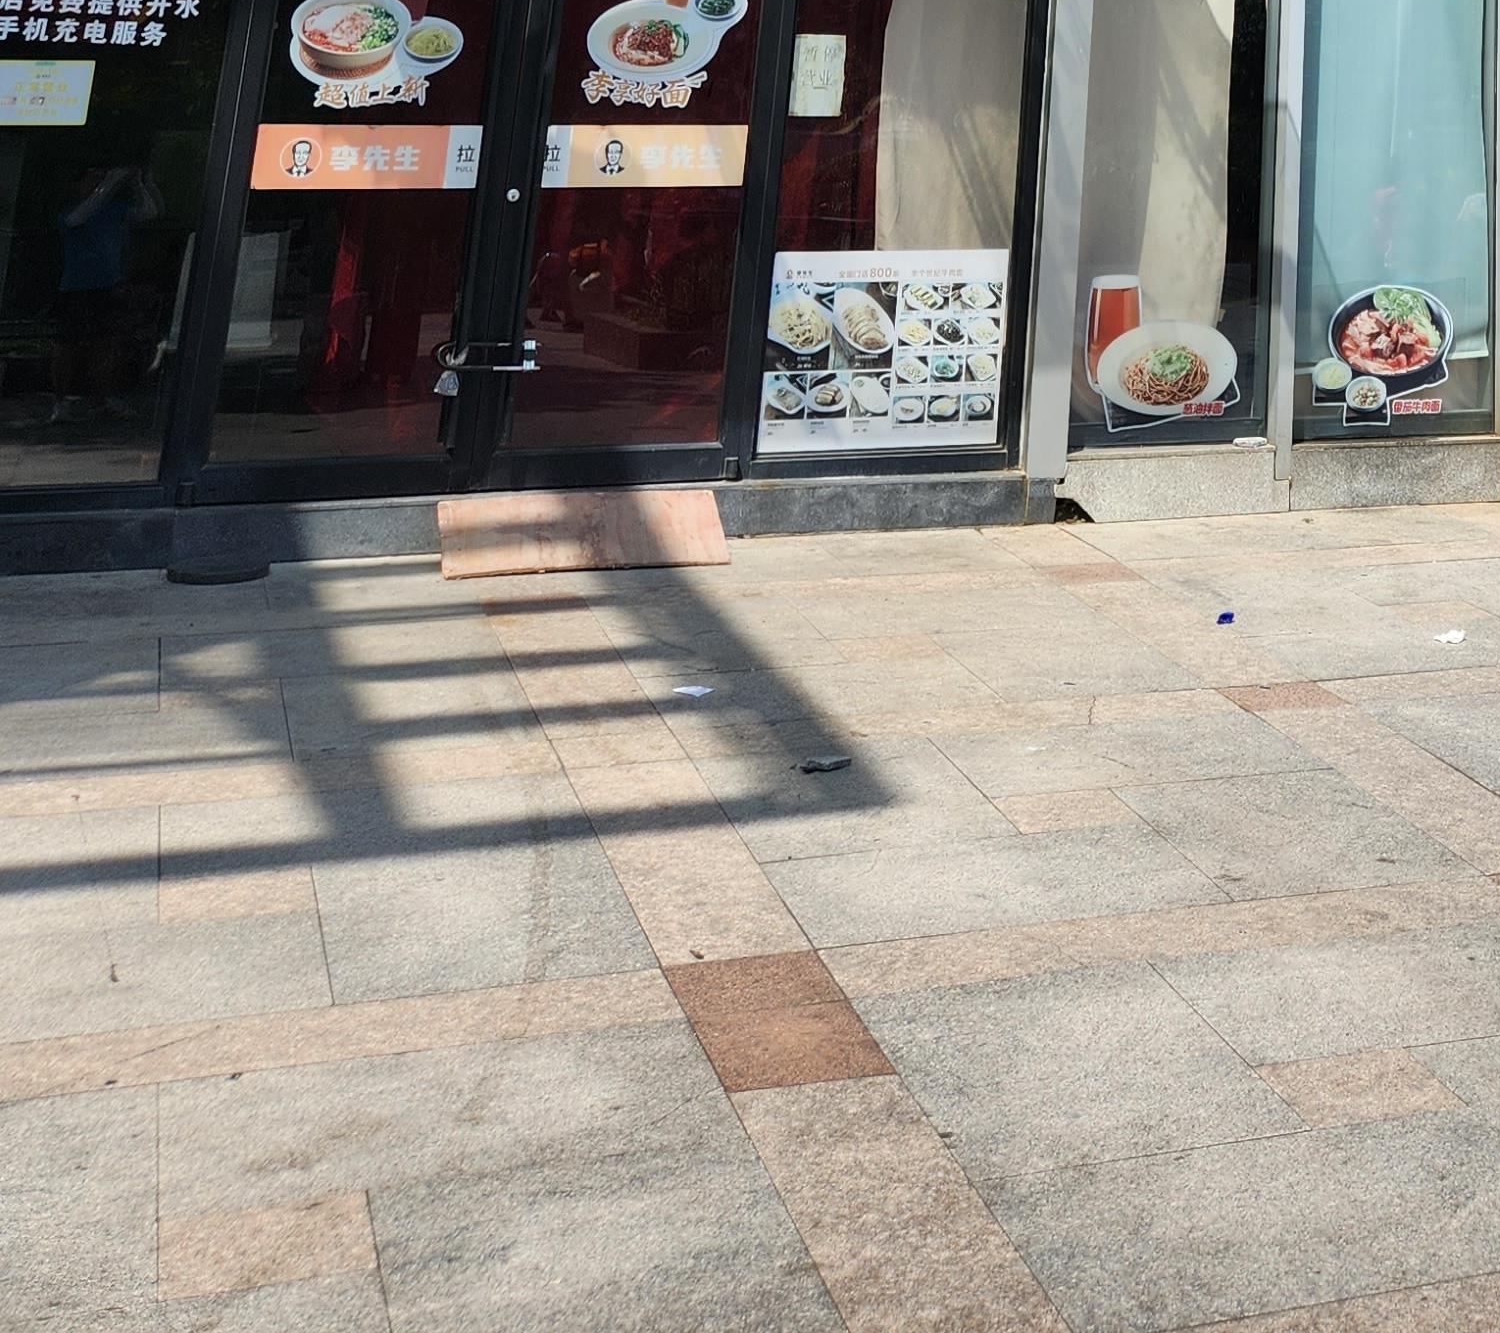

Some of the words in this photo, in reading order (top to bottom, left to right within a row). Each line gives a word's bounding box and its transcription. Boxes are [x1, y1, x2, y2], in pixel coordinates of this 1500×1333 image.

[0, 16, 168, 47] 手机充电服务
[313, 76, 430, 110] 超值上新
[581, 69, 708, 109] 李享好面
[329, 144, 421, 172] 李先生
[456, 144, 476, 164] 拉
[639, 144, 722, 171] 李先生
[1393, 399, 1442, 414] 番茄牛肉面
